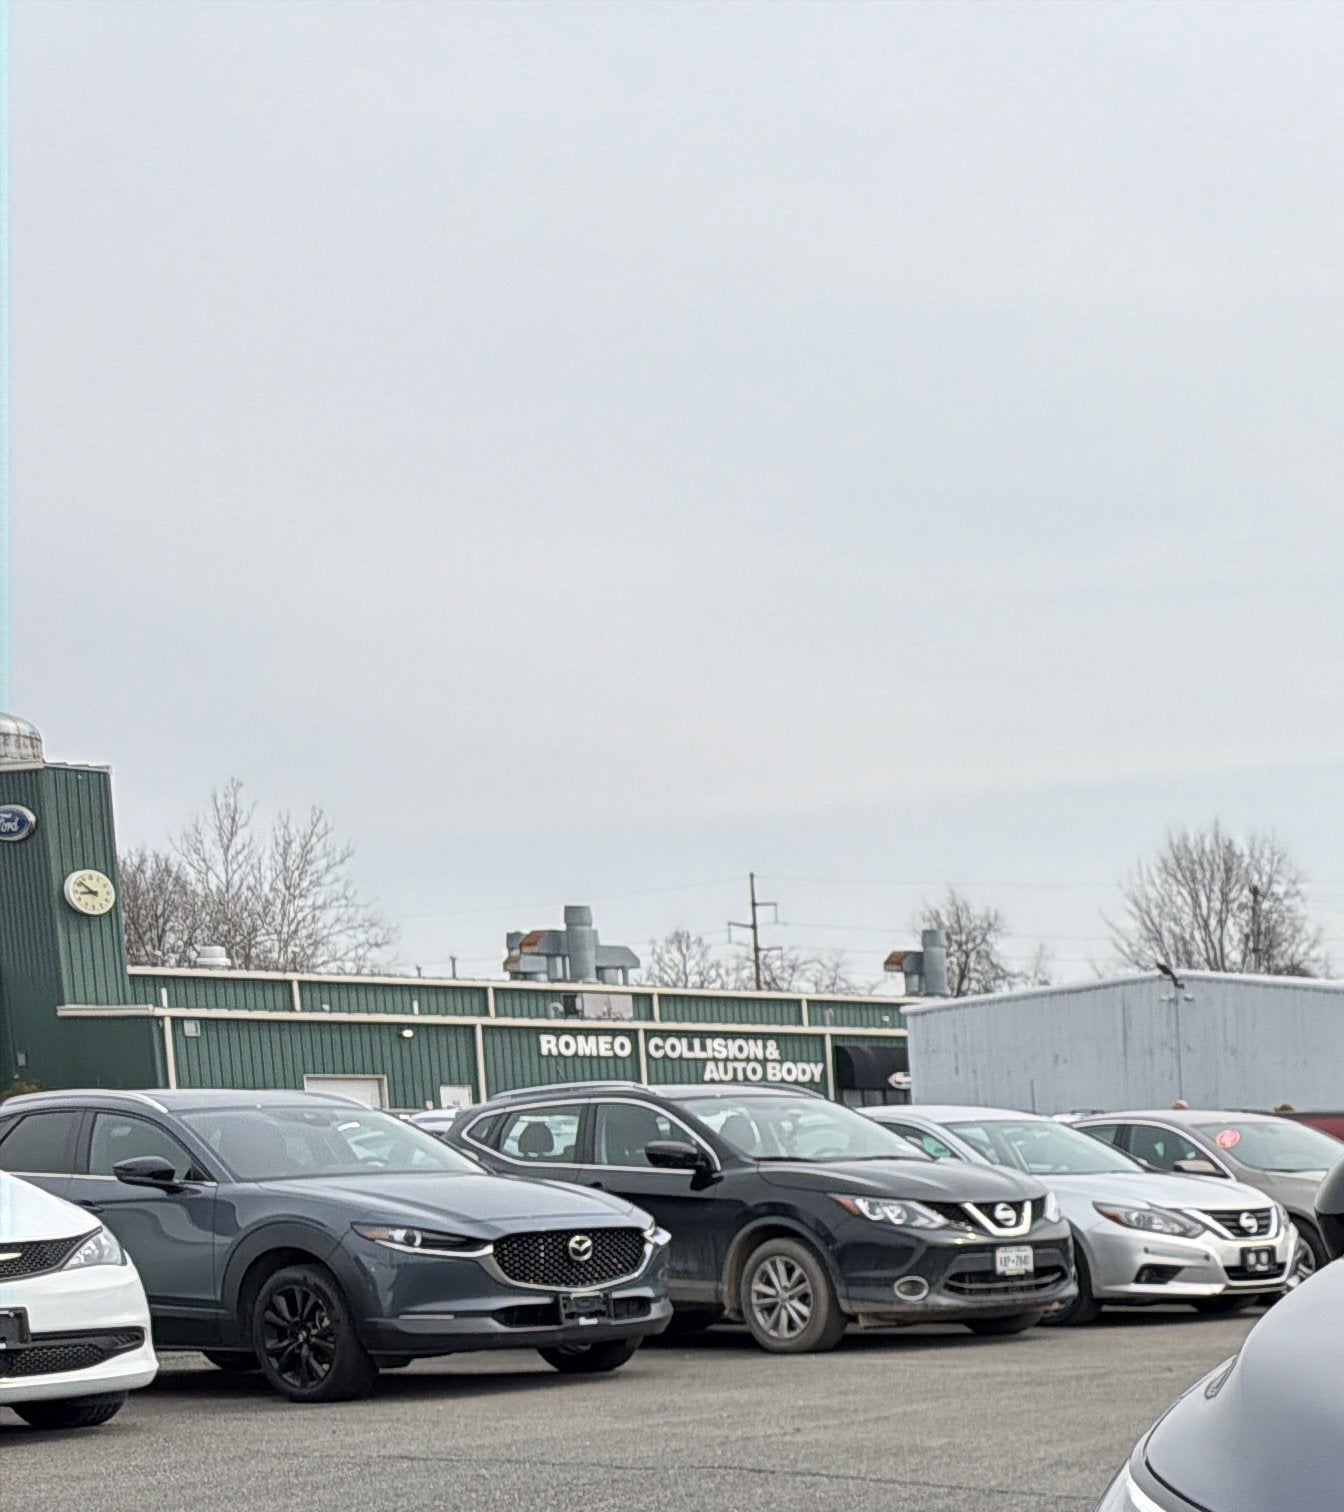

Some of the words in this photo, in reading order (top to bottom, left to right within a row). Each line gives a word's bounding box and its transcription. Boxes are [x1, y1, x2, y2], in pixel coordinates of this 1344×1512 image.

[539, 1034, 632, 1058] ROMEO
[648, 1036, 764, 1060] COLLISION
[765, 1039, 780, 1060] &
[703, 1061, 763, 1082] AUTO
[766, 1062, 824, 1083] BODY
